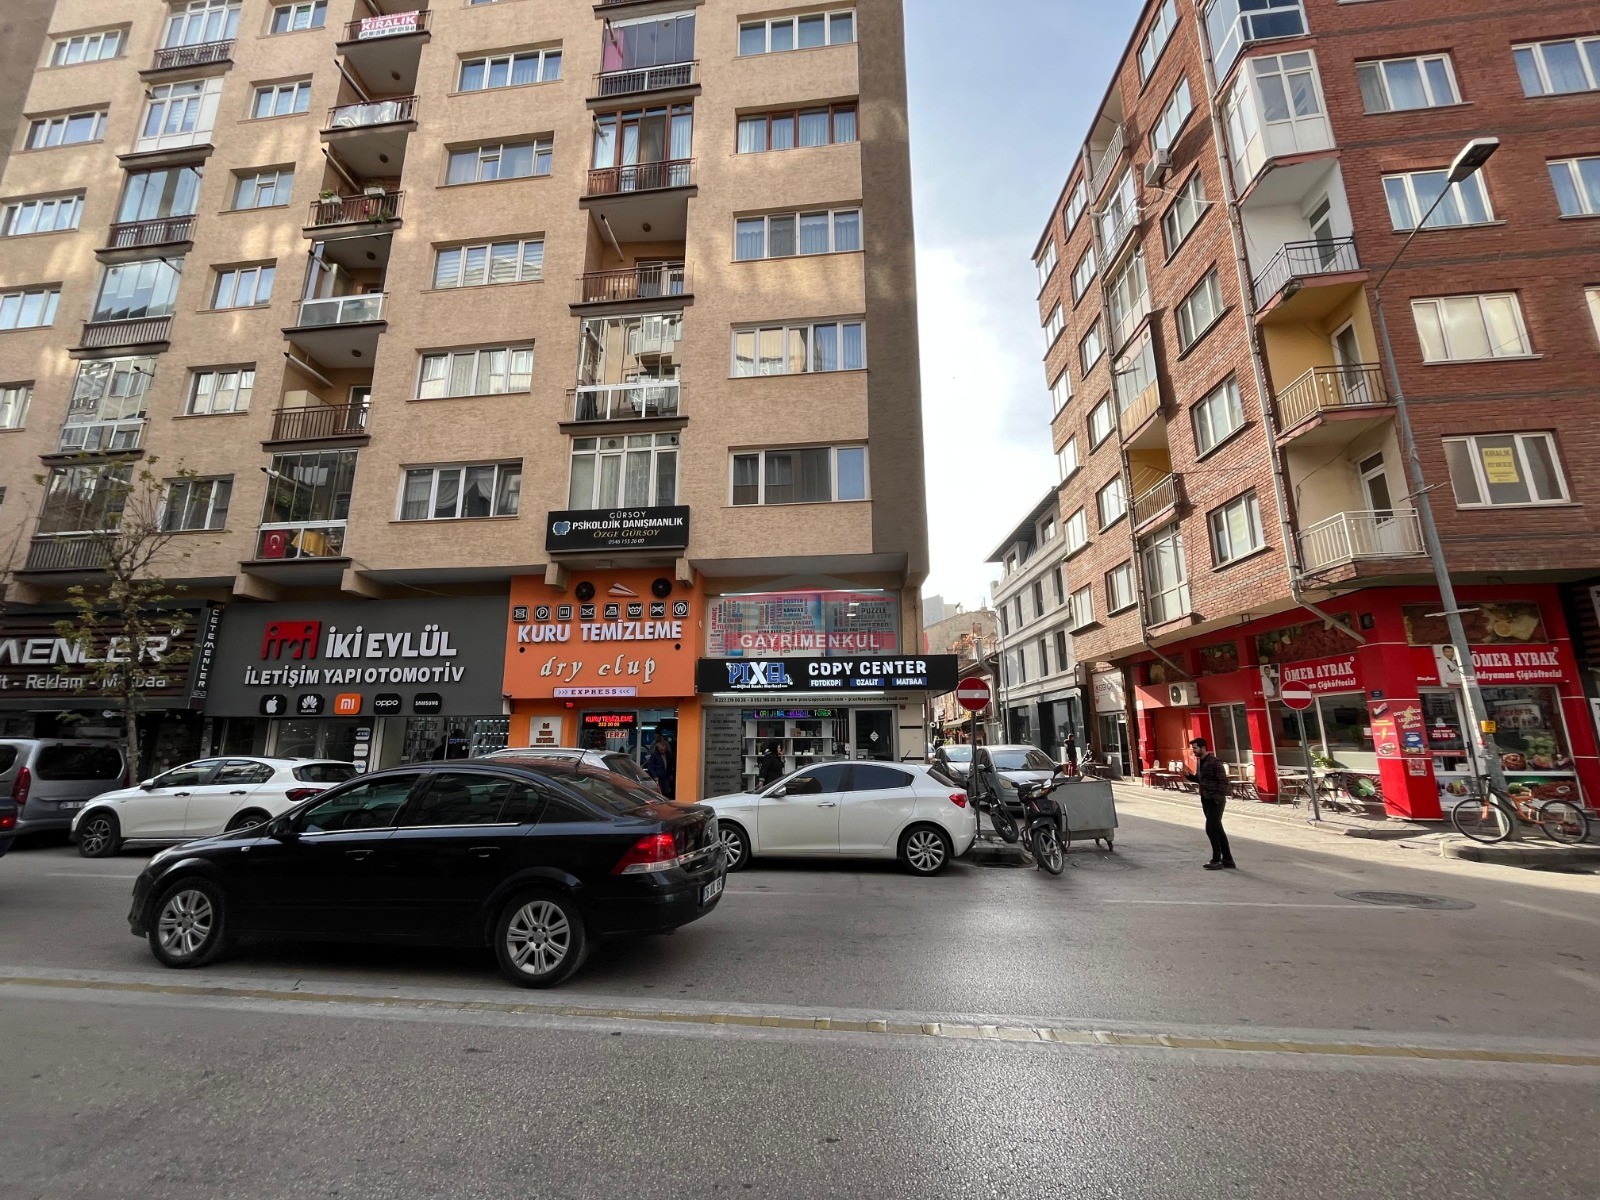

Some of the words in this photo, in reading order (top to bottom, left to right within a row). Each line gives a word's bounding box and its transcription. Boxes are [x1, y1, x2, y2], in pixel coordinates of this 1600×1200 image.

[609, 511, 646, 519] GÜRSOY
[572, 520, 620, 530] PSİKOLOJİK
[623, 518, 683, 528] DANIŞMANLIK
[593, 530, 619, 538] ÖZGE
[622, 529, 660, 538] GÜRSOY
[518, 624, 571, 643] KURU
[581, 619, 682, 641] TEMİZLEME
[325, 625, 363, 658] İKİ
[366, 624, 457, 658] EYLÜL
[1471, 651, 1512, 667] ÖMER
[1514, 652, 1559, 666] AYBAK
[245, 665, 320, 687] İLETİŞİM
[324, 668, 362, 684] YAPI
[364, 662, 465, 683] OTOMOTİV
[540, 656, 583, 683] dry
[598, 654, 656, 683] clup
[808, 662, 854, 676] COPY
[859, 661, 928, 675] CENTER
[1284, 668, 1314, 682] ÖMER
[1316, 662, 1354, 678] AYBAK
[1476, 671, 1514, 680] Adıyaman
[26, 674, 83, 690] Reklam
[102, 674, 166, 689] Mbaa
